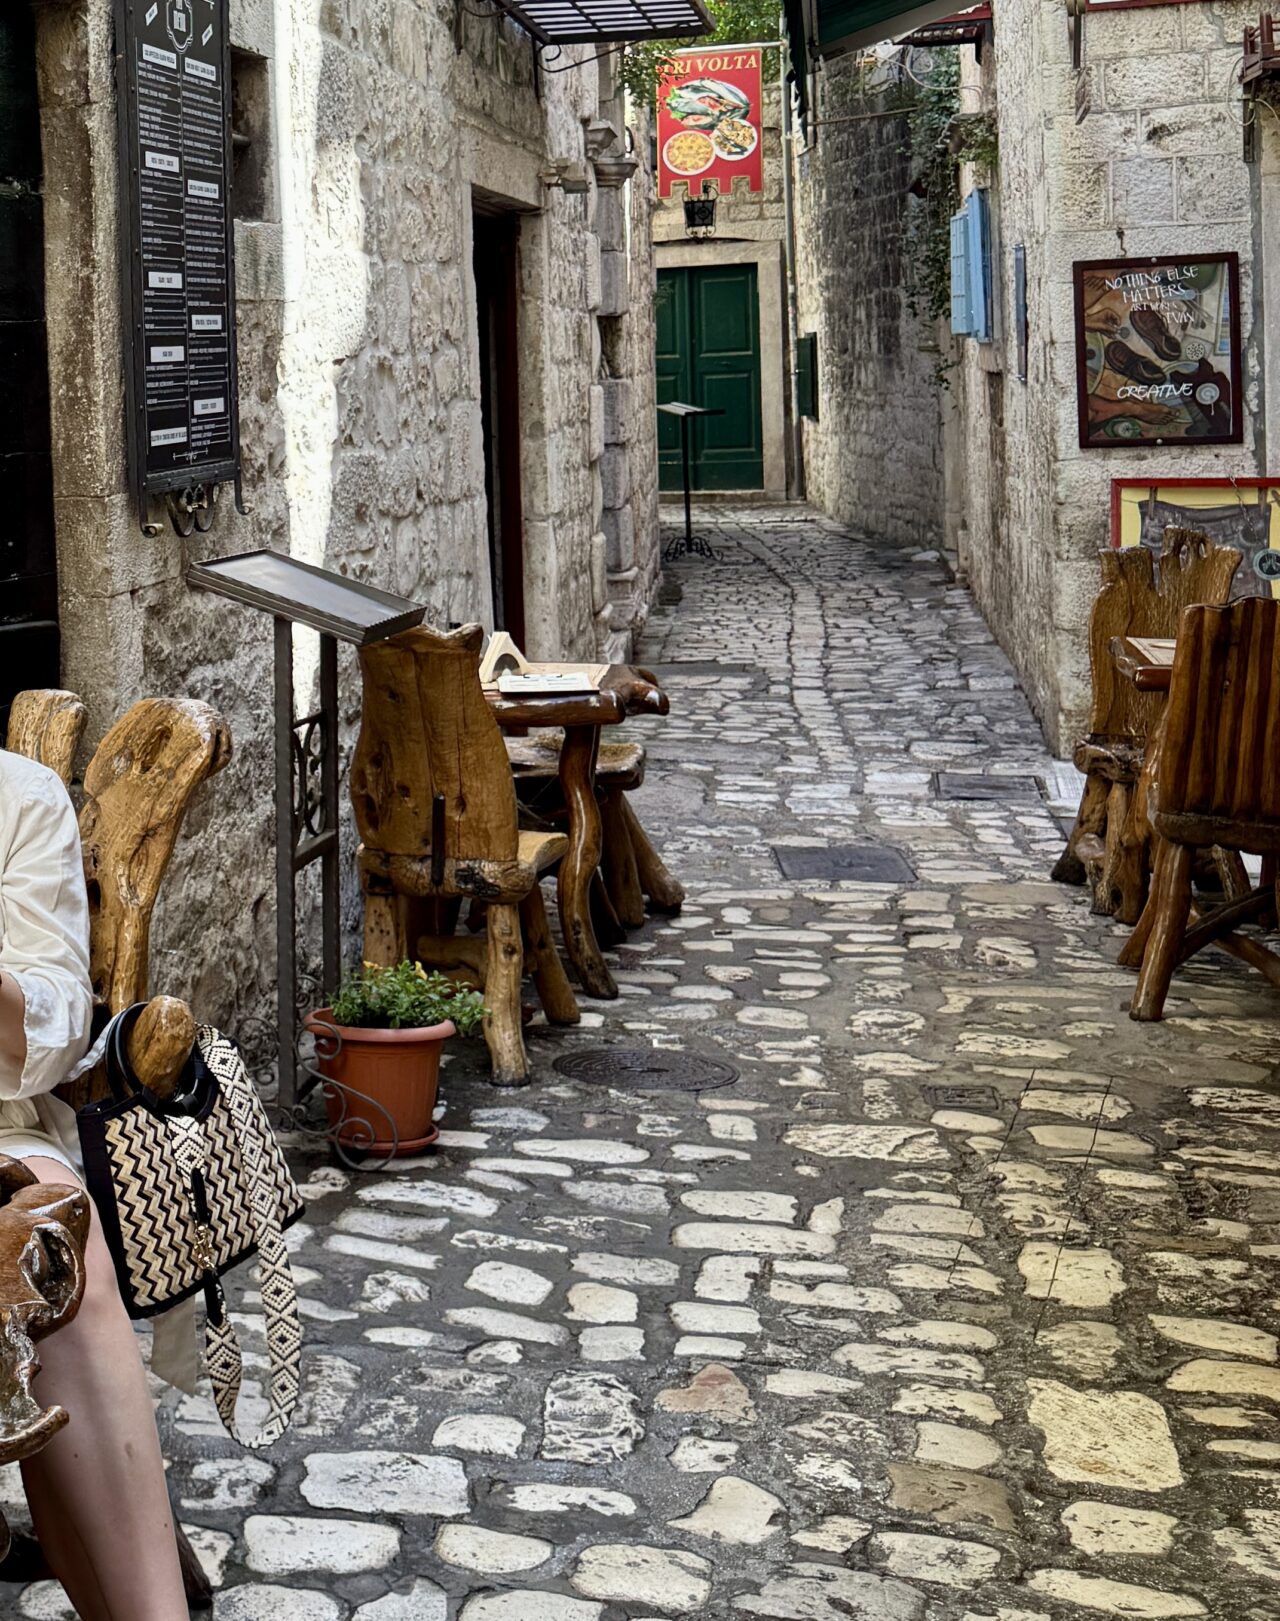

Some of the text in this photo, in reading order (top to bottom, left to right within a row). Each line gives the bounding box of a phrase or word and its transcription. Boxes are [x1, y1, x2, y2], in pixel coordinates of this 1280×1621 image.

[696, 55, 757, 72] VOLTA
[1105, 266, 1199, 290] NOTHING ELSE
[1123, 283, 1185, 303] MATTERS
[1117, 383, 1193, 400] CREATIVE
